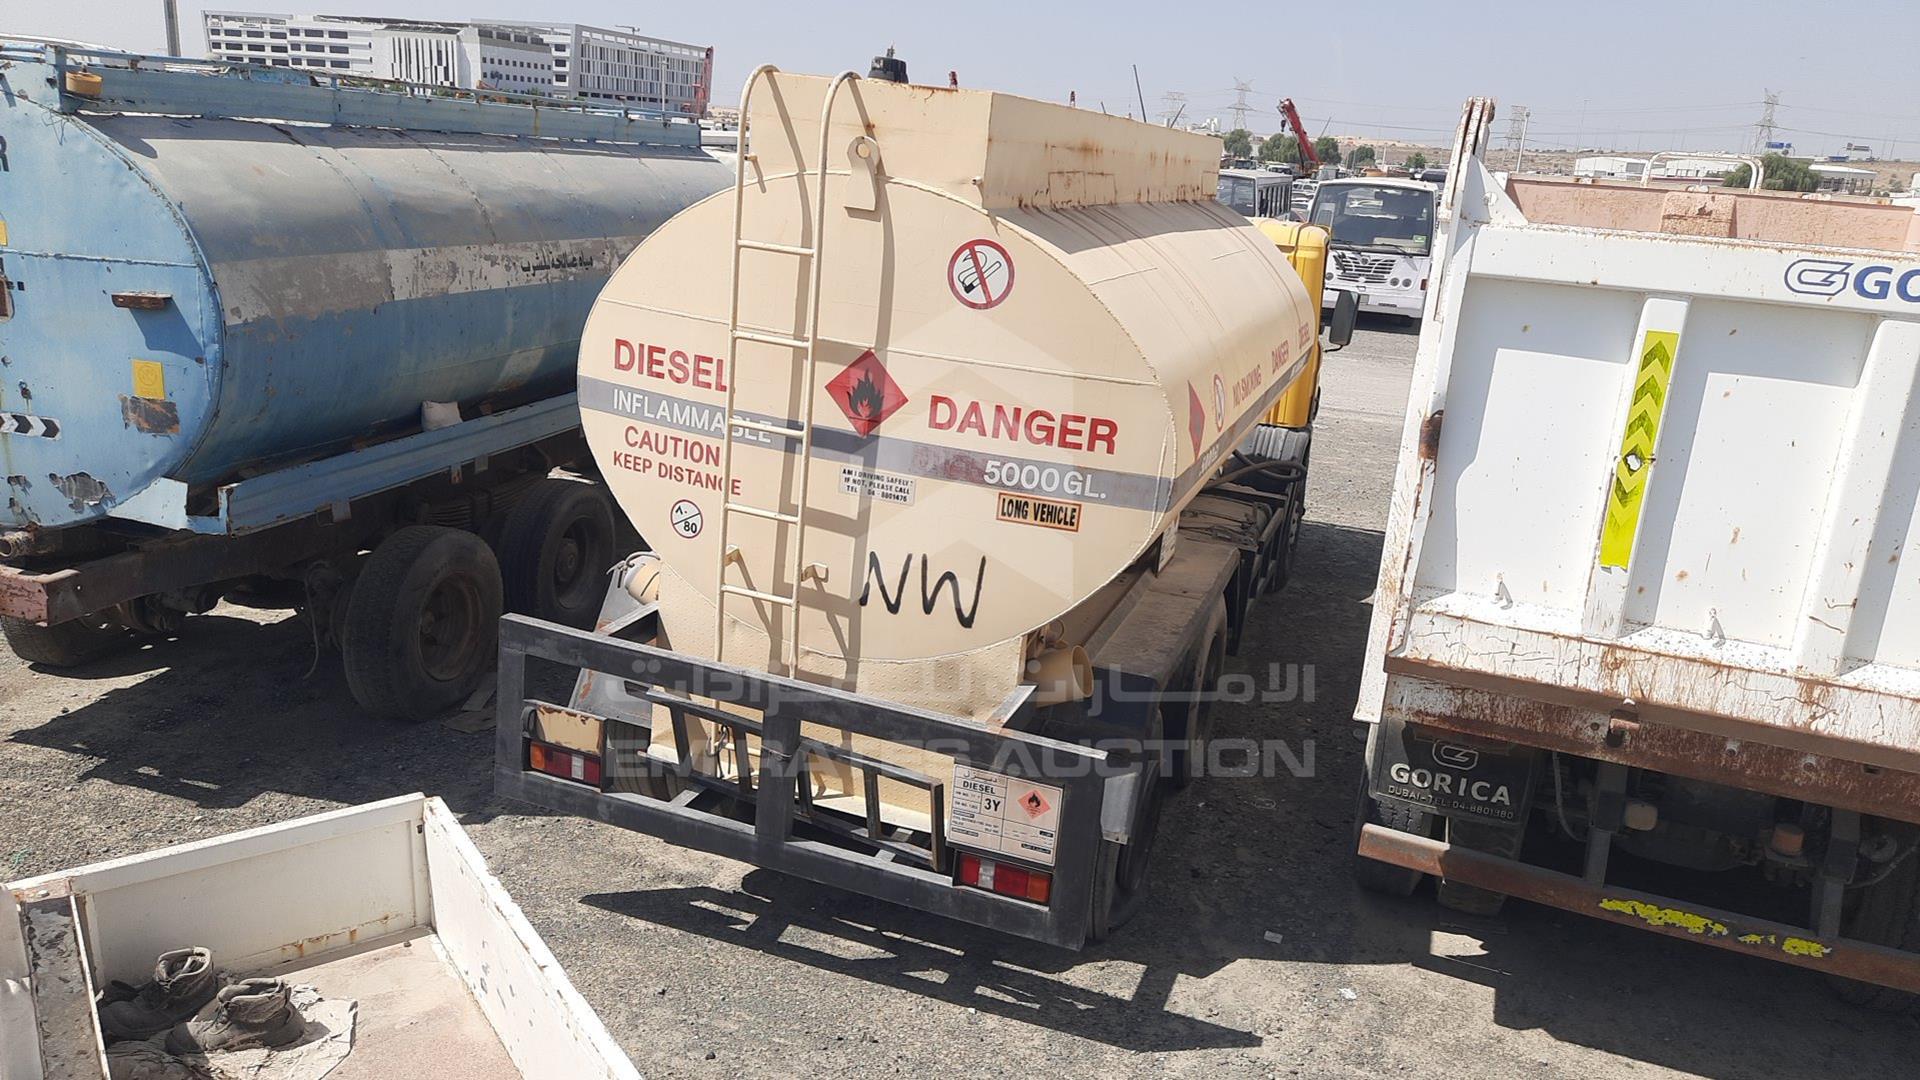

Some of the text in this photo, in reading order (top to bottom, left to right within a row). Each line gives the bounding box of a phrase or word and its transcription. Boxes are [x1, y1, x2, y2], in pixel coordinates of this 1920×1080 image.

[614, 338, 727, 393] DIESEL
[928, 394, 1119, 455] DANGER
[624, 425, 720, 467] CAUTION
[613, 451, 651, 478] KEEP
[868, 480, 893, 492] PLEASE
[894, 485, 910, 495] CALL
[1001, 497, 1077, 527] LONG VEHICLE
[684, 520, 697, 534] 80
[962, 780, 996, 795] DIESEL
[1390, 762, 1511, 806] GORICA
[984, 798, 1001, 812] 3Y
